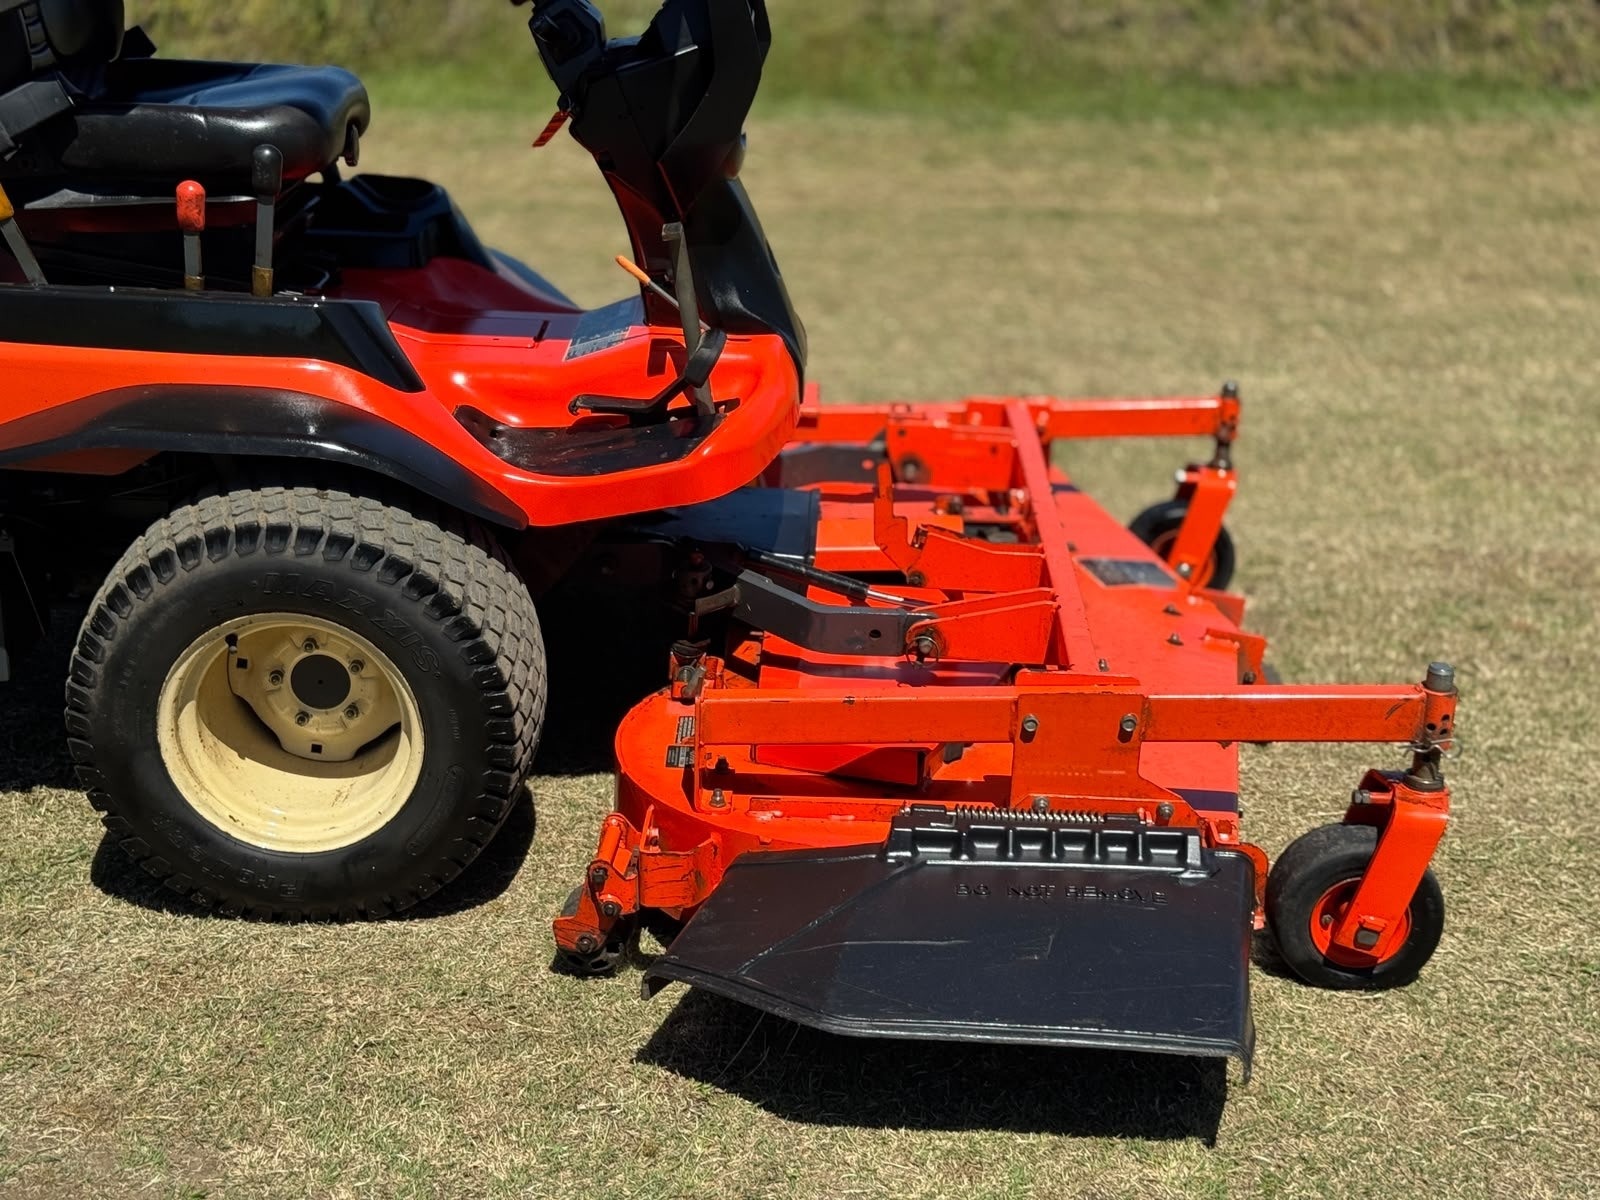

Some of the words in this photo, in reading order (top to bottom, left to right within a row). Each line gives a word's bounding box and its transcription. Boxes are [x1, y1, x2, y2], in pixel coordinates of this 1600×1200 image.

[264, 572, 440, 673] MAXXIS
[956, 884, 991, 898] DO
[1008, 884, 1056, 898] NOT
[1065, 886, 1168, 905] REMOVE
